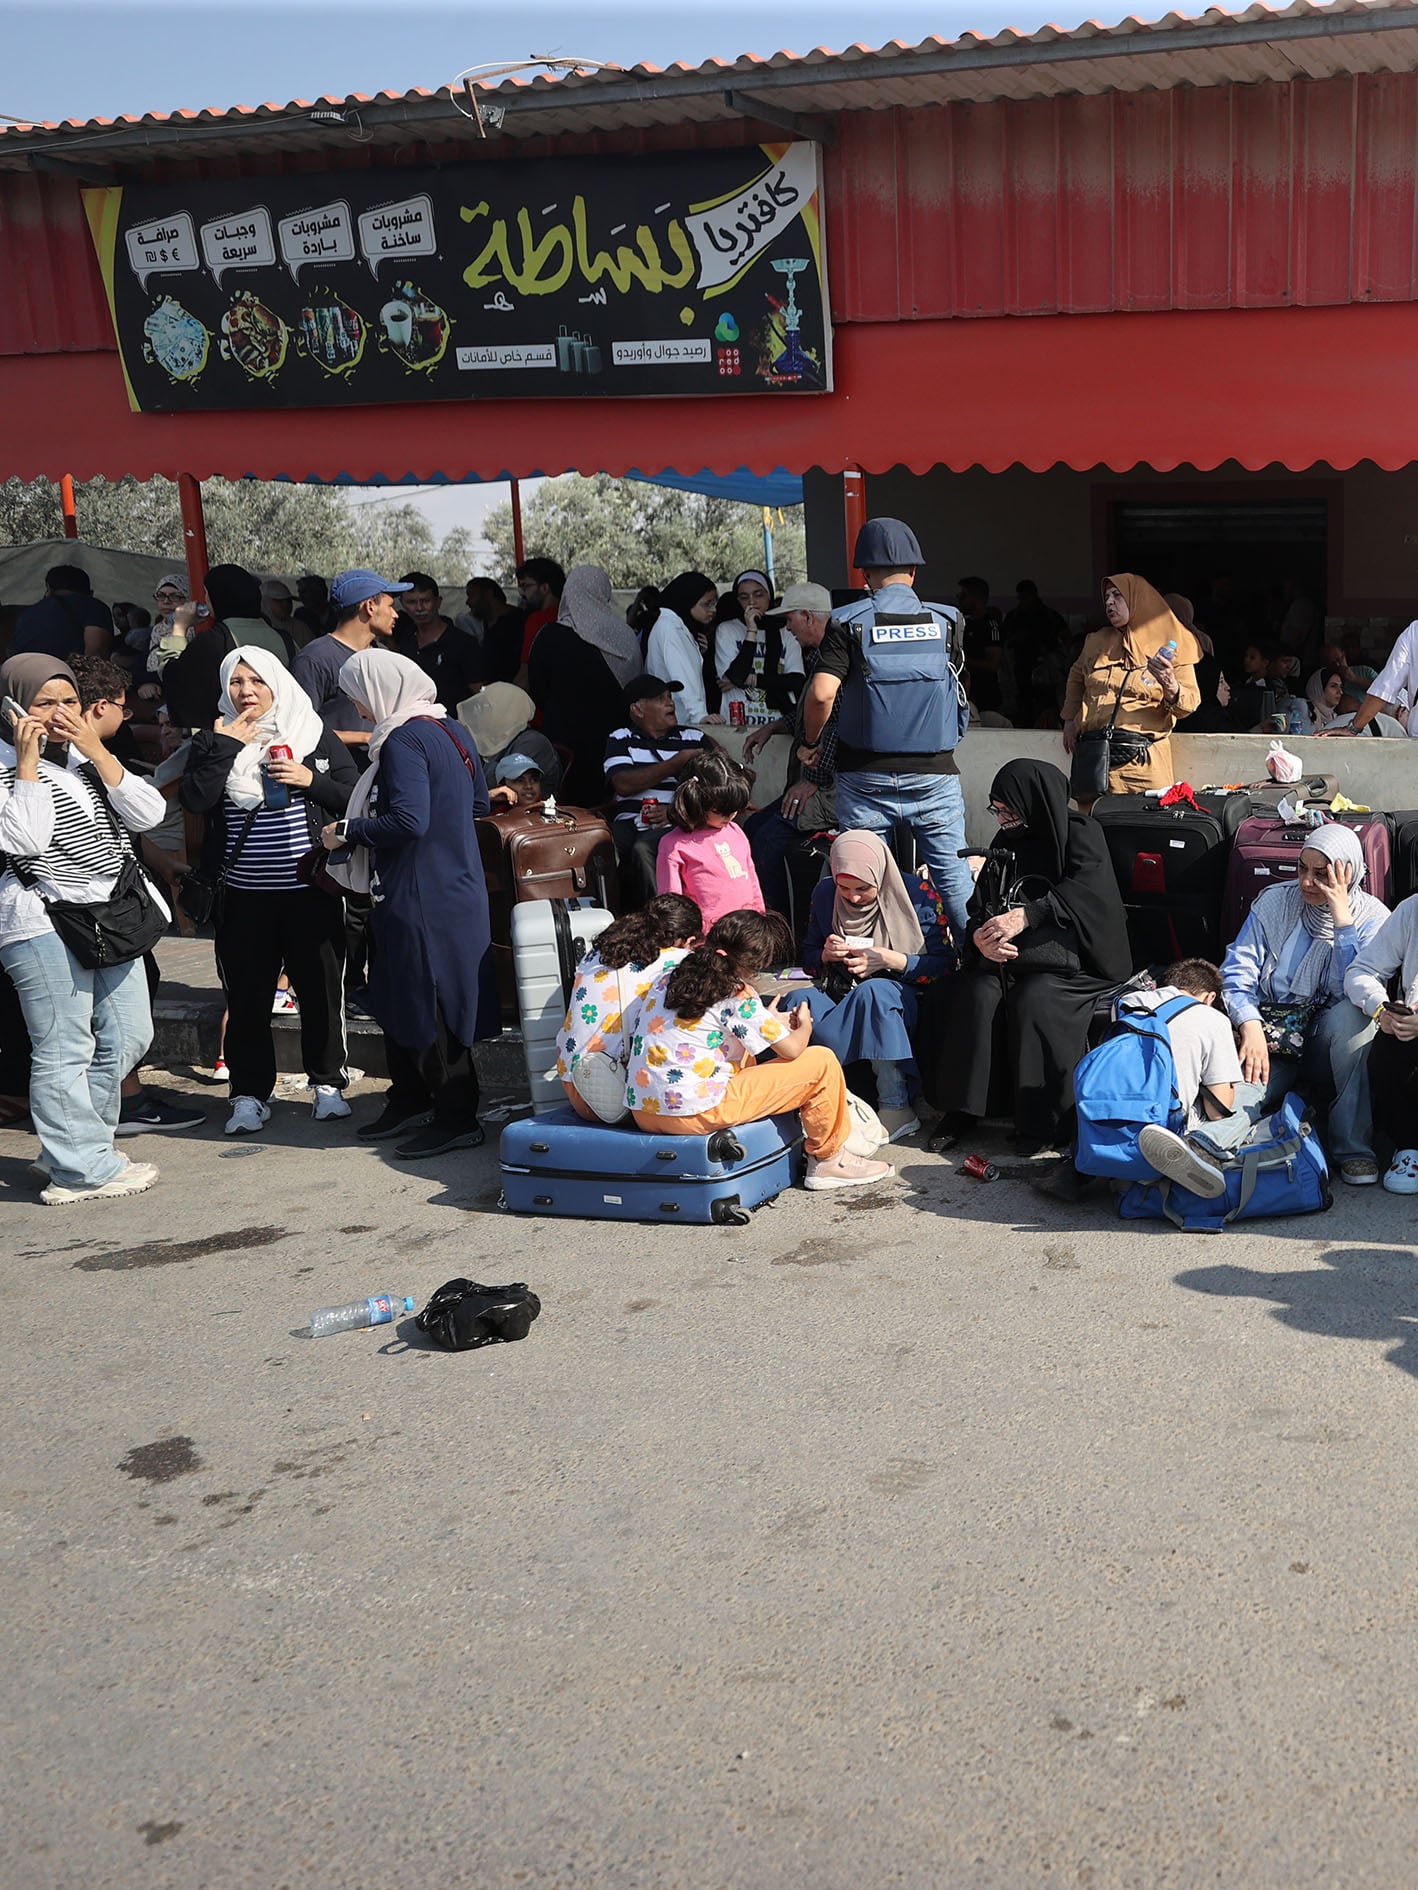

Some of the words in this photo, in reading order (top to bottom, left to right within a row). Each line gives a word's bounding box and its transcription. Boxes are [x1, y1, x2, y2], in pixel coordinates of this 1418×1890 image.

[291, 213, 341, 237] مشروبات
[372, 208, 423, 232] مشروبات
[137, 227, 179, 245] صرافة
[214, 224, 256, 240] وجبات
[381, 231, 421, 249] ساخنة
[222, 245, 257, 261] سريعة
[303, 238, 337, 256] باردة
[461, 348, 498, 364] للأمانات
[500, 349, 522, 365] خاص
[525, 348, 553, 366] قسم
[654, 344, 680, 360] جوال
[682, 346, 707, 359] رصيد
[876, 627, 938, 640] PRESS
